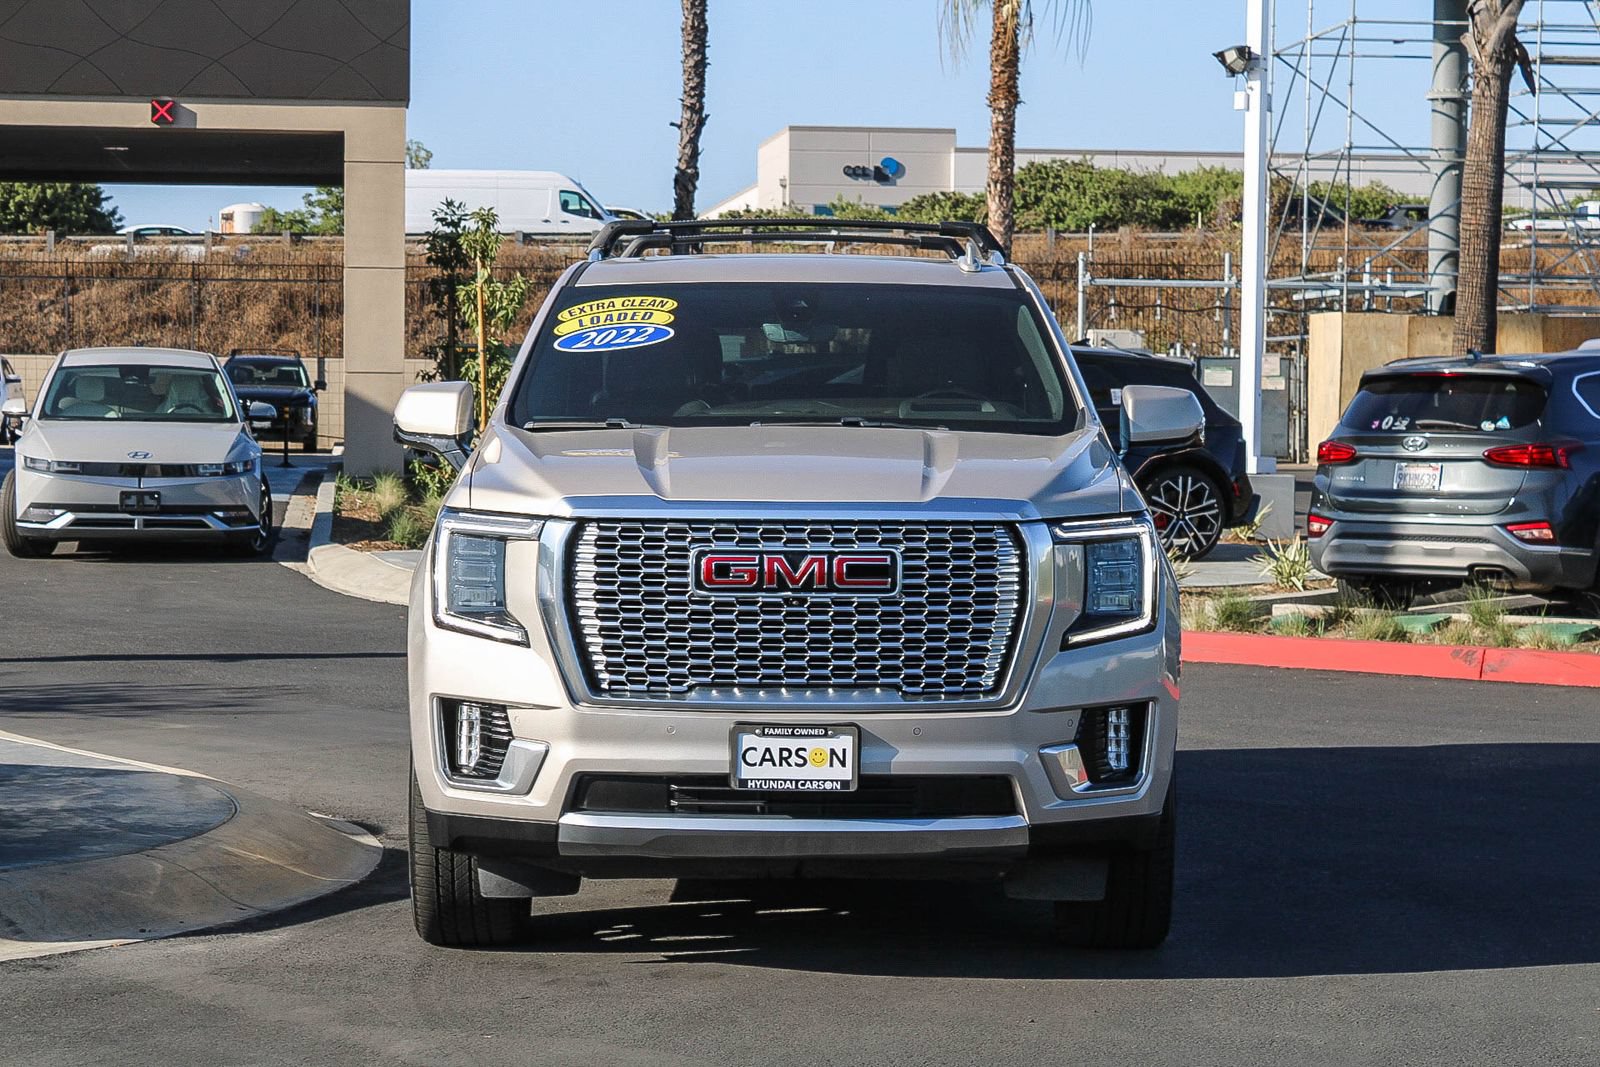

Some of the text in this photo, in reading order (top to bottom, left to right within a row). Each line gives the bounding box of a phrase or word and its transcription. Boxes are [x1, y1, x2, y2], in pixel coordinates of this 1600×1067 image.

[568, 298, 669, 317] EXTRA CLEAN
[578, 311, 655, 328] LOADED
[571, 327, 655, 348] 2022
[702, 555, 891, 588] GMC
[764, 727, 825, 736] FAMILY OWNED
[747, 780, 841, 790] HYUNDAI CARSON
